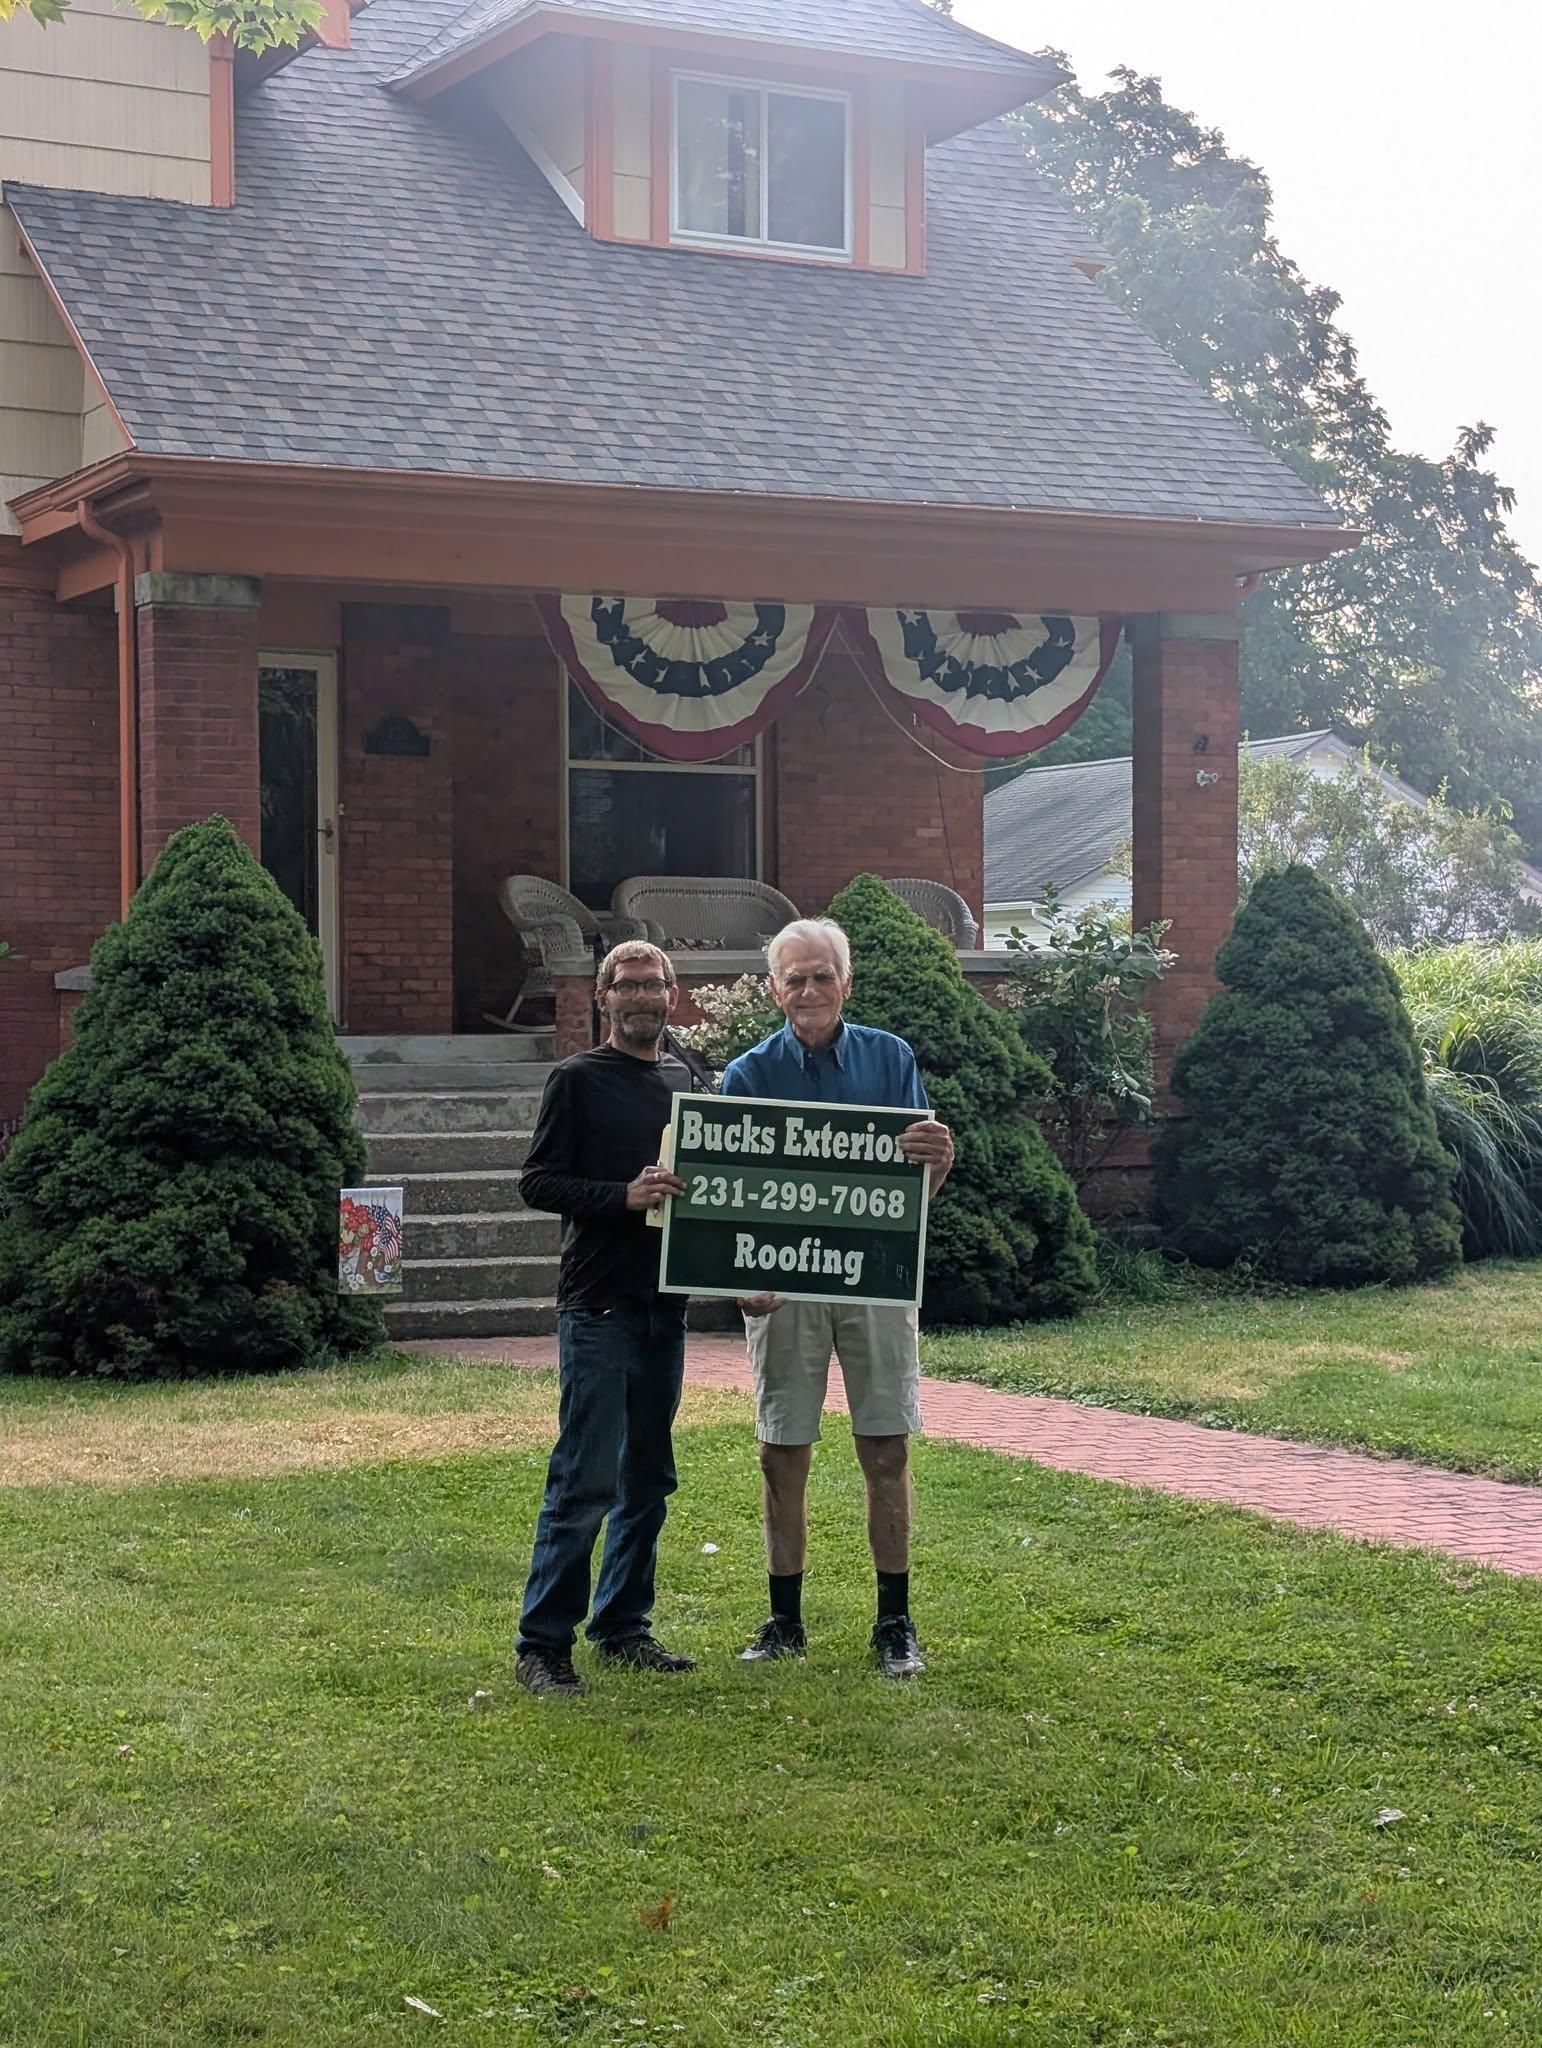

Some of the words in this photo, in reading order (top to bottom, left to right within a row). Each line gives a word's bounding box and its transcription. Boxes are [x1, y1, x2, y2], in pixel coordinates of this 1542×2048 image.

[681, 1110, 776, 1155] Bucks
[783, 1116, 919, 1164] Exterior
[690, 1175, 906, 1219] 231-299-7068
[734, 1232, 864, 1286] Roofing
